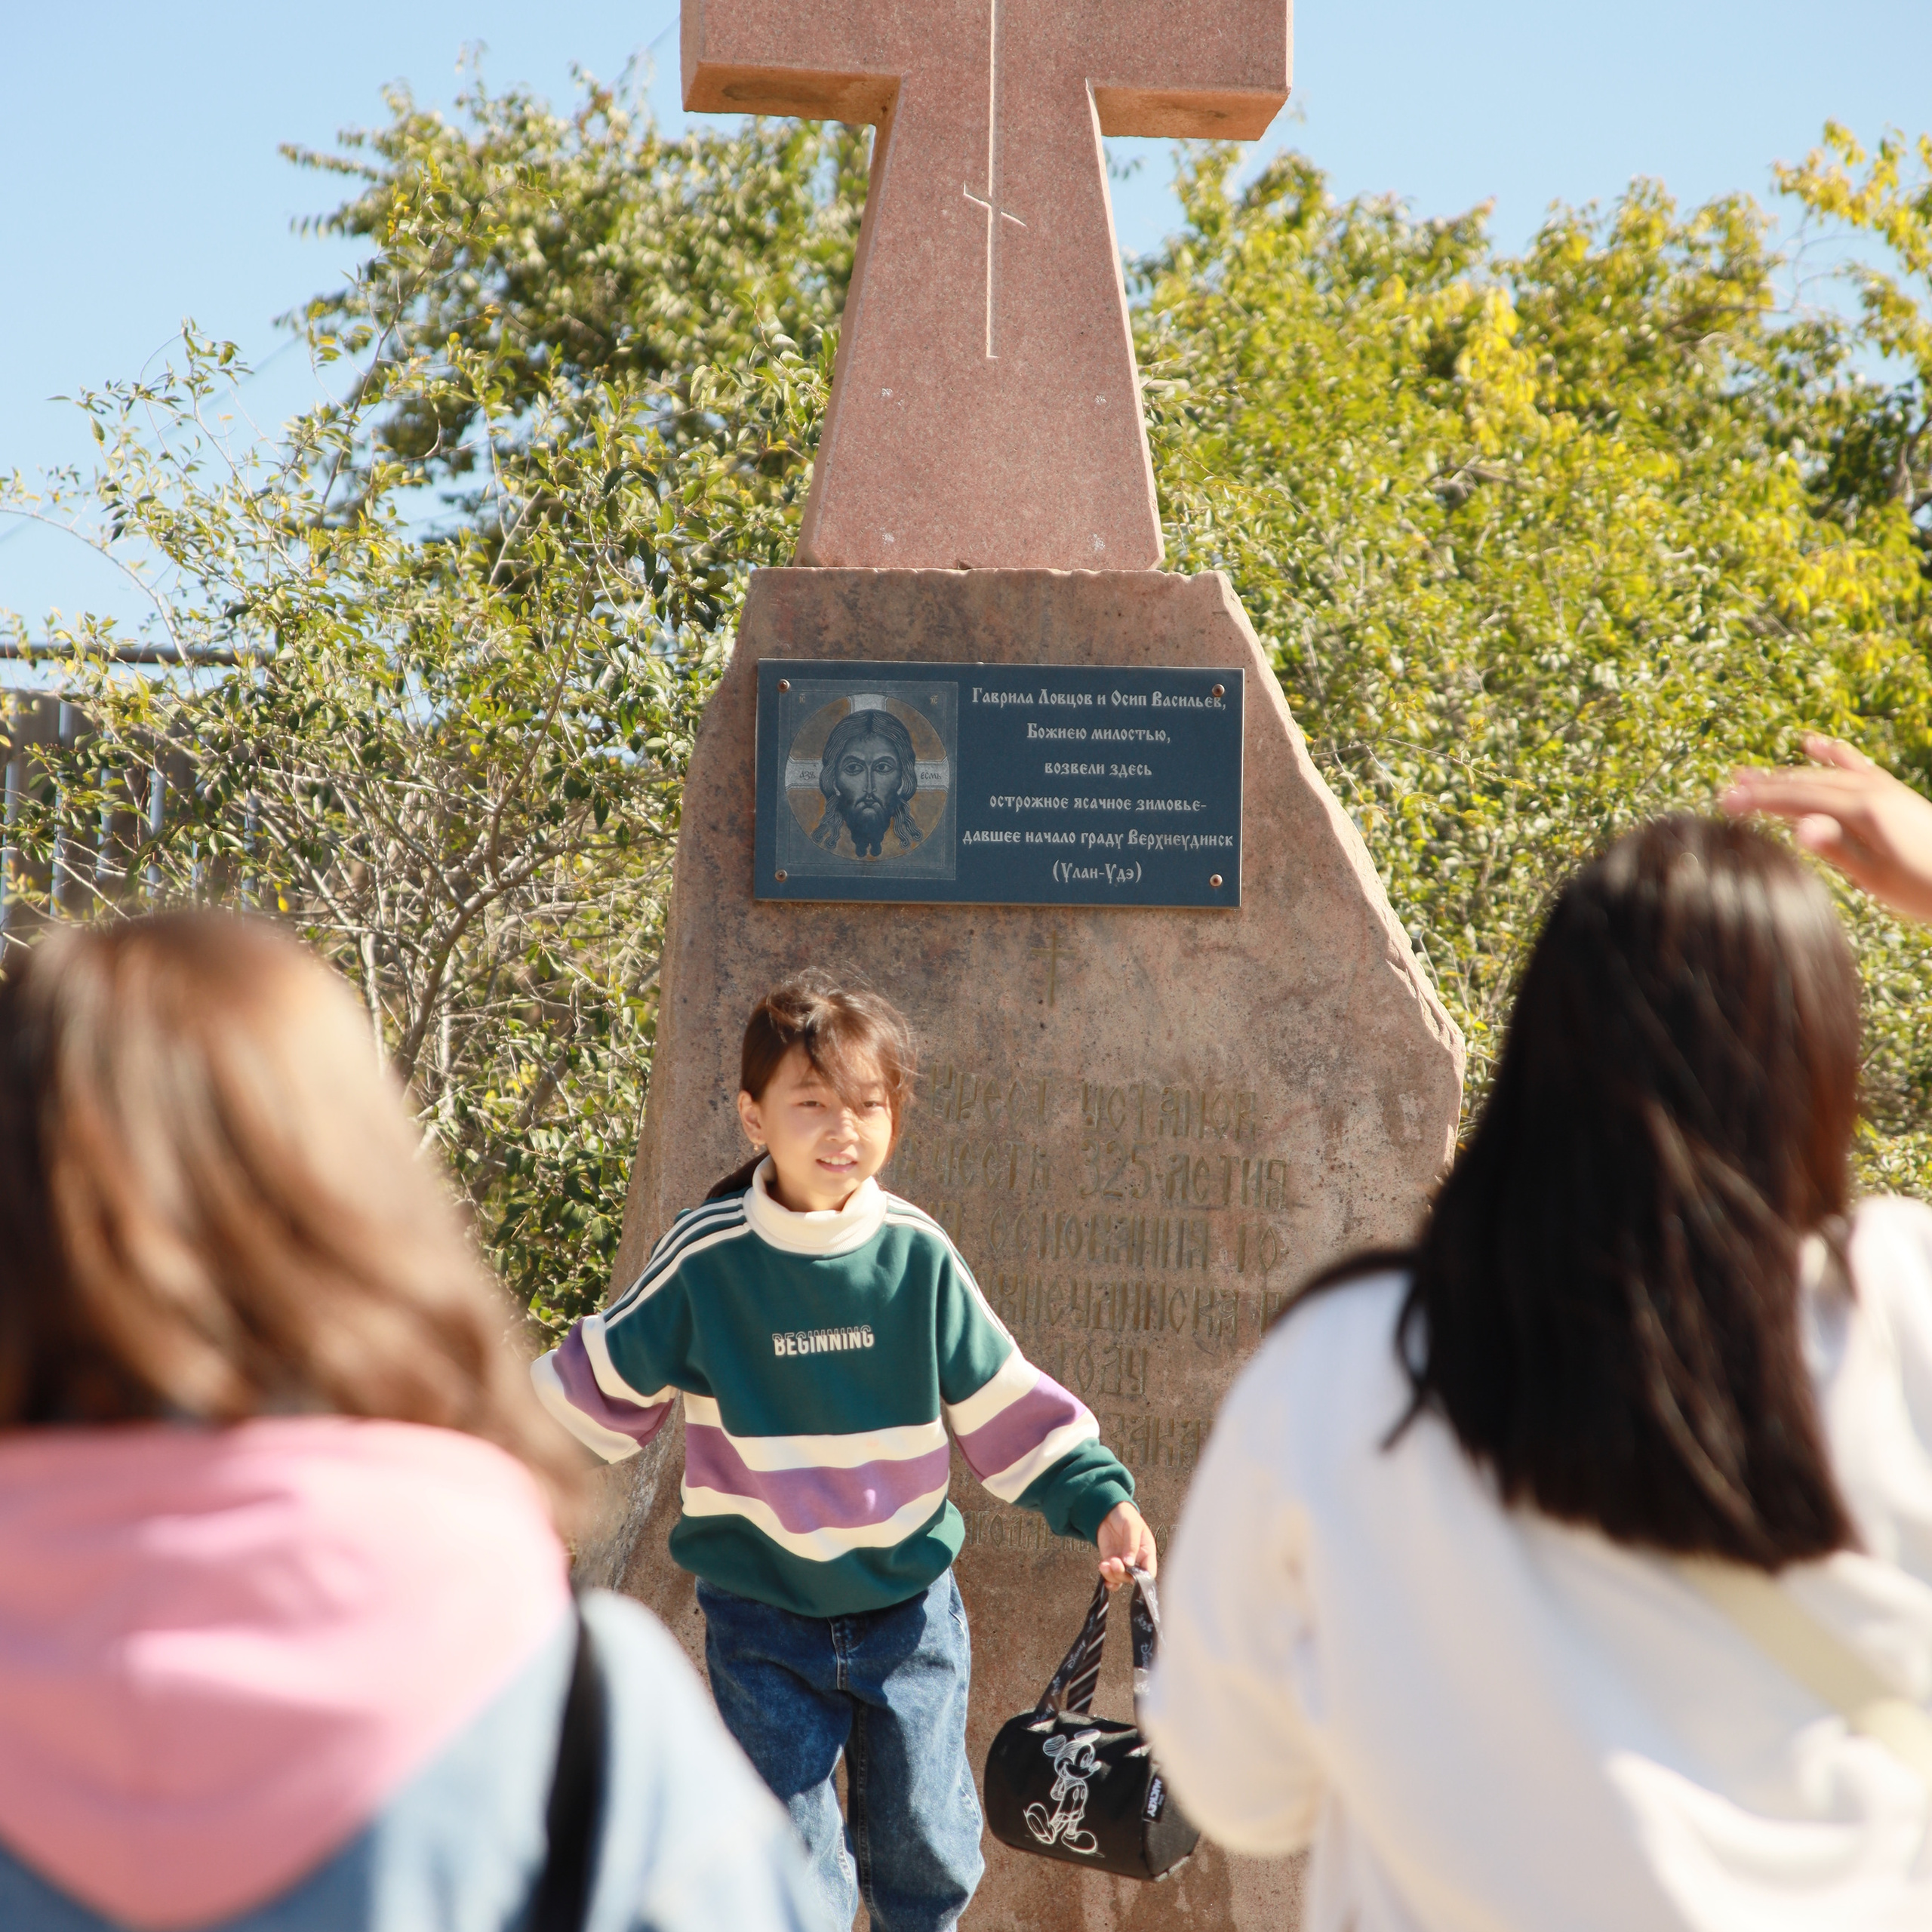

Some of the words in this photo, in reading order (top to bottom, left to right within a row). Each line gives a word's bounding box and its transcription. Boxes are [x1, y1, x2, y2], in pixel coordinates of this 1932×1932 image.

[971, 687, 1034, 709] Гаврила
[1038, 688, 1093, 708] Ловцов
[1097, 694, 1106, 706] и
[1111, 689, 1147, 706] Осип
[1151, 691, 1226, 711] Васильев,
[1026, 722, 1087, 740] Божиею
[1091, 728, 1171, 743] милостью,
[1044, 761, 1105, 775] возвели
[1109, 762, 1152, 778] здесь
[989, 795, 1069, 813] острожное
[1073, 797, 1132, 811] ясачное
[1135, 798, 1207, 811] зимовье-
[962, 829, 1021, 845] давшее
[1026, 831, 1076, 844] начало
[1081, 832, 1123, 849] граду
[1128, 829, 1233, 851] Верхнеудинск
[1052, 859, 1142, 884] (Улан-Удэ)
[772, 1324, 875, 1356] BEGINNING
